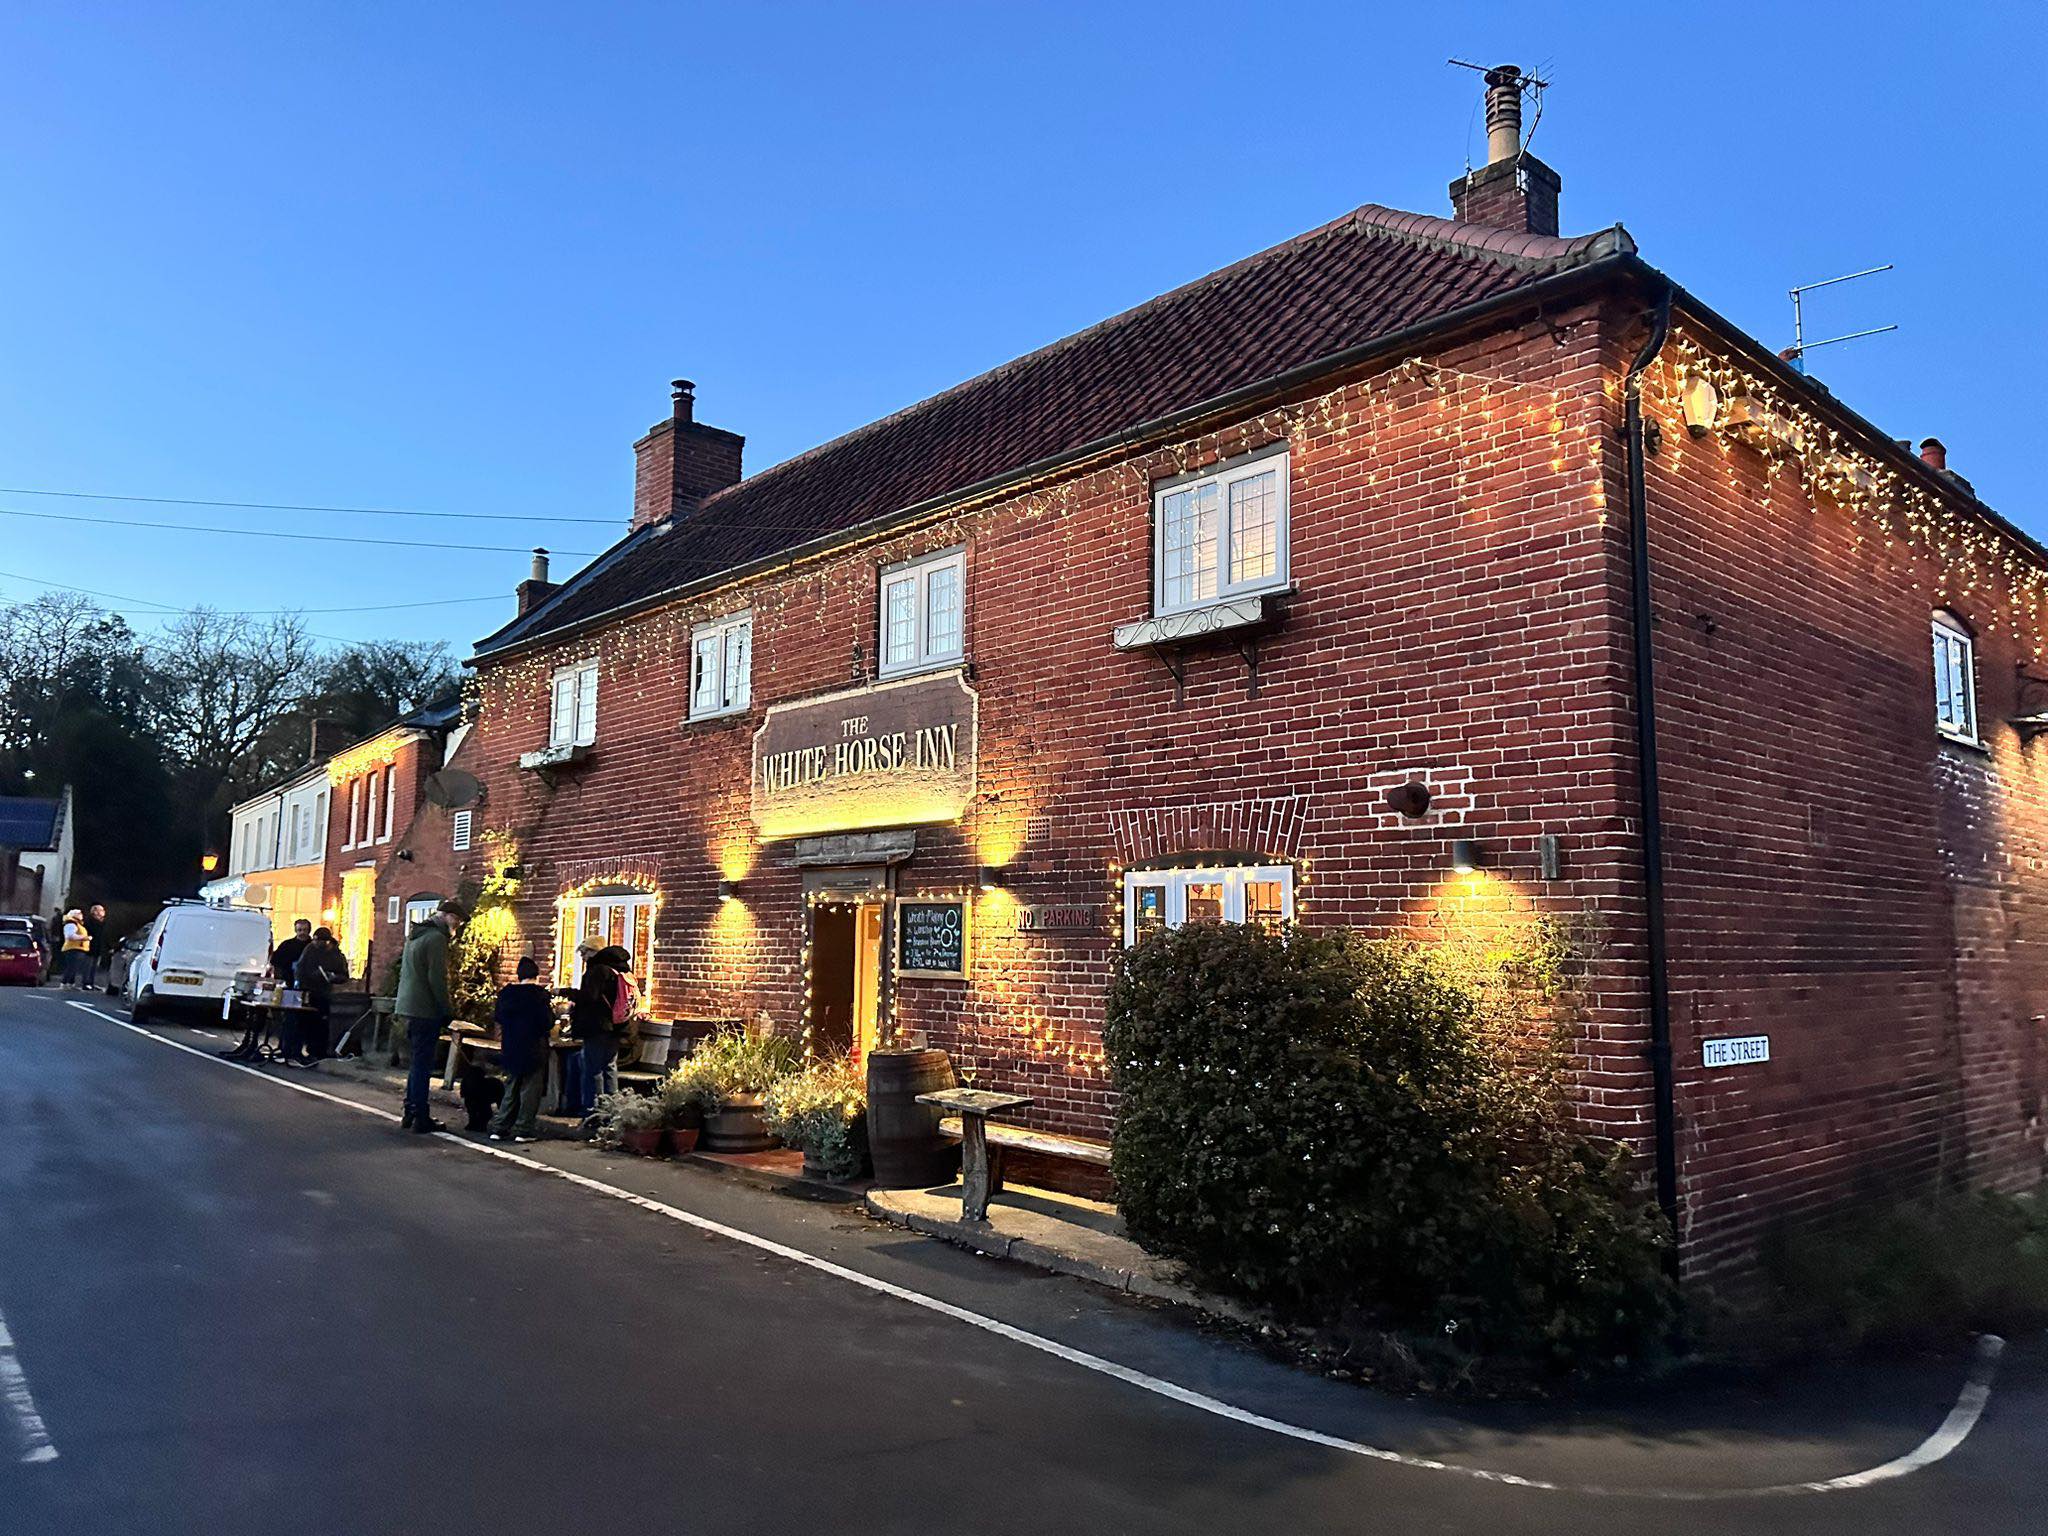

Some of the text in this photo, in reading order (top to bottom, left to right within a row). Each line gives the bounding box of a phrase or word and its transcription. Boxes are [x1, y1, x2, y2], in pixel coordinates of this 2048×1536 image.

[841, 715, 869, 737] THE
[762, 723, 959, 795] WHITE HORSE INN
[1018, 908, 1092, 928] NO PARKING
[1705, 1040, 1767, 1063] THE STREET
